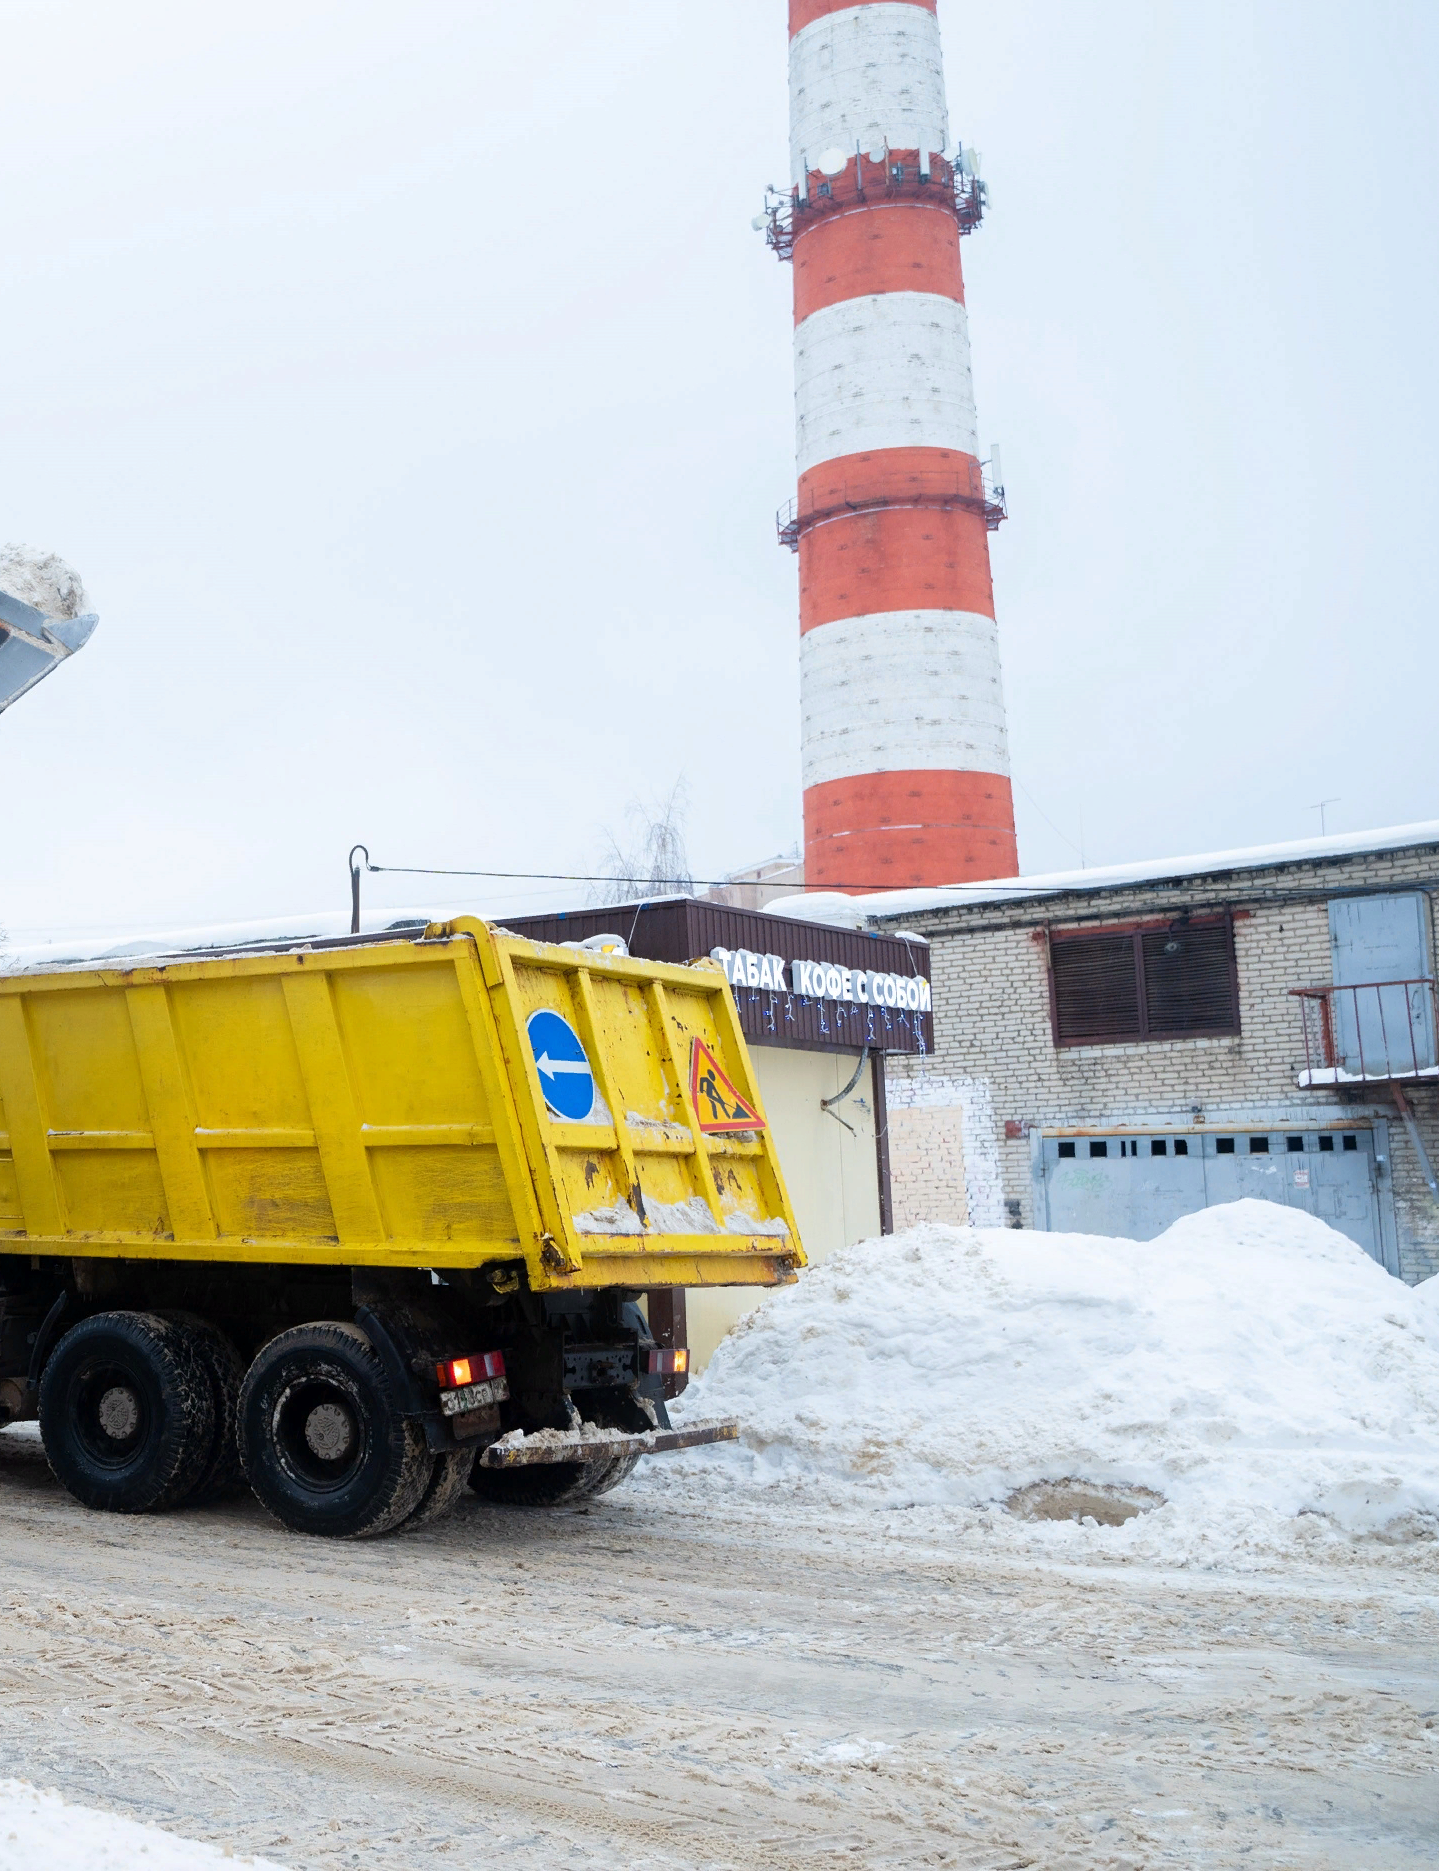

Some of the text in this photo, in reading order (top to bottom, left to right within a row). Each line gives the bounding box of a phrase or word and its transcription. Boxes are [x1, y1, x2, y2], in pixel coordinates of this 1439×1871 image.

[718, 950, 787, 991] ТАБАК
[799, 962, 853, 1000] КОФЕ
[856, 970, 869, 1004] С
